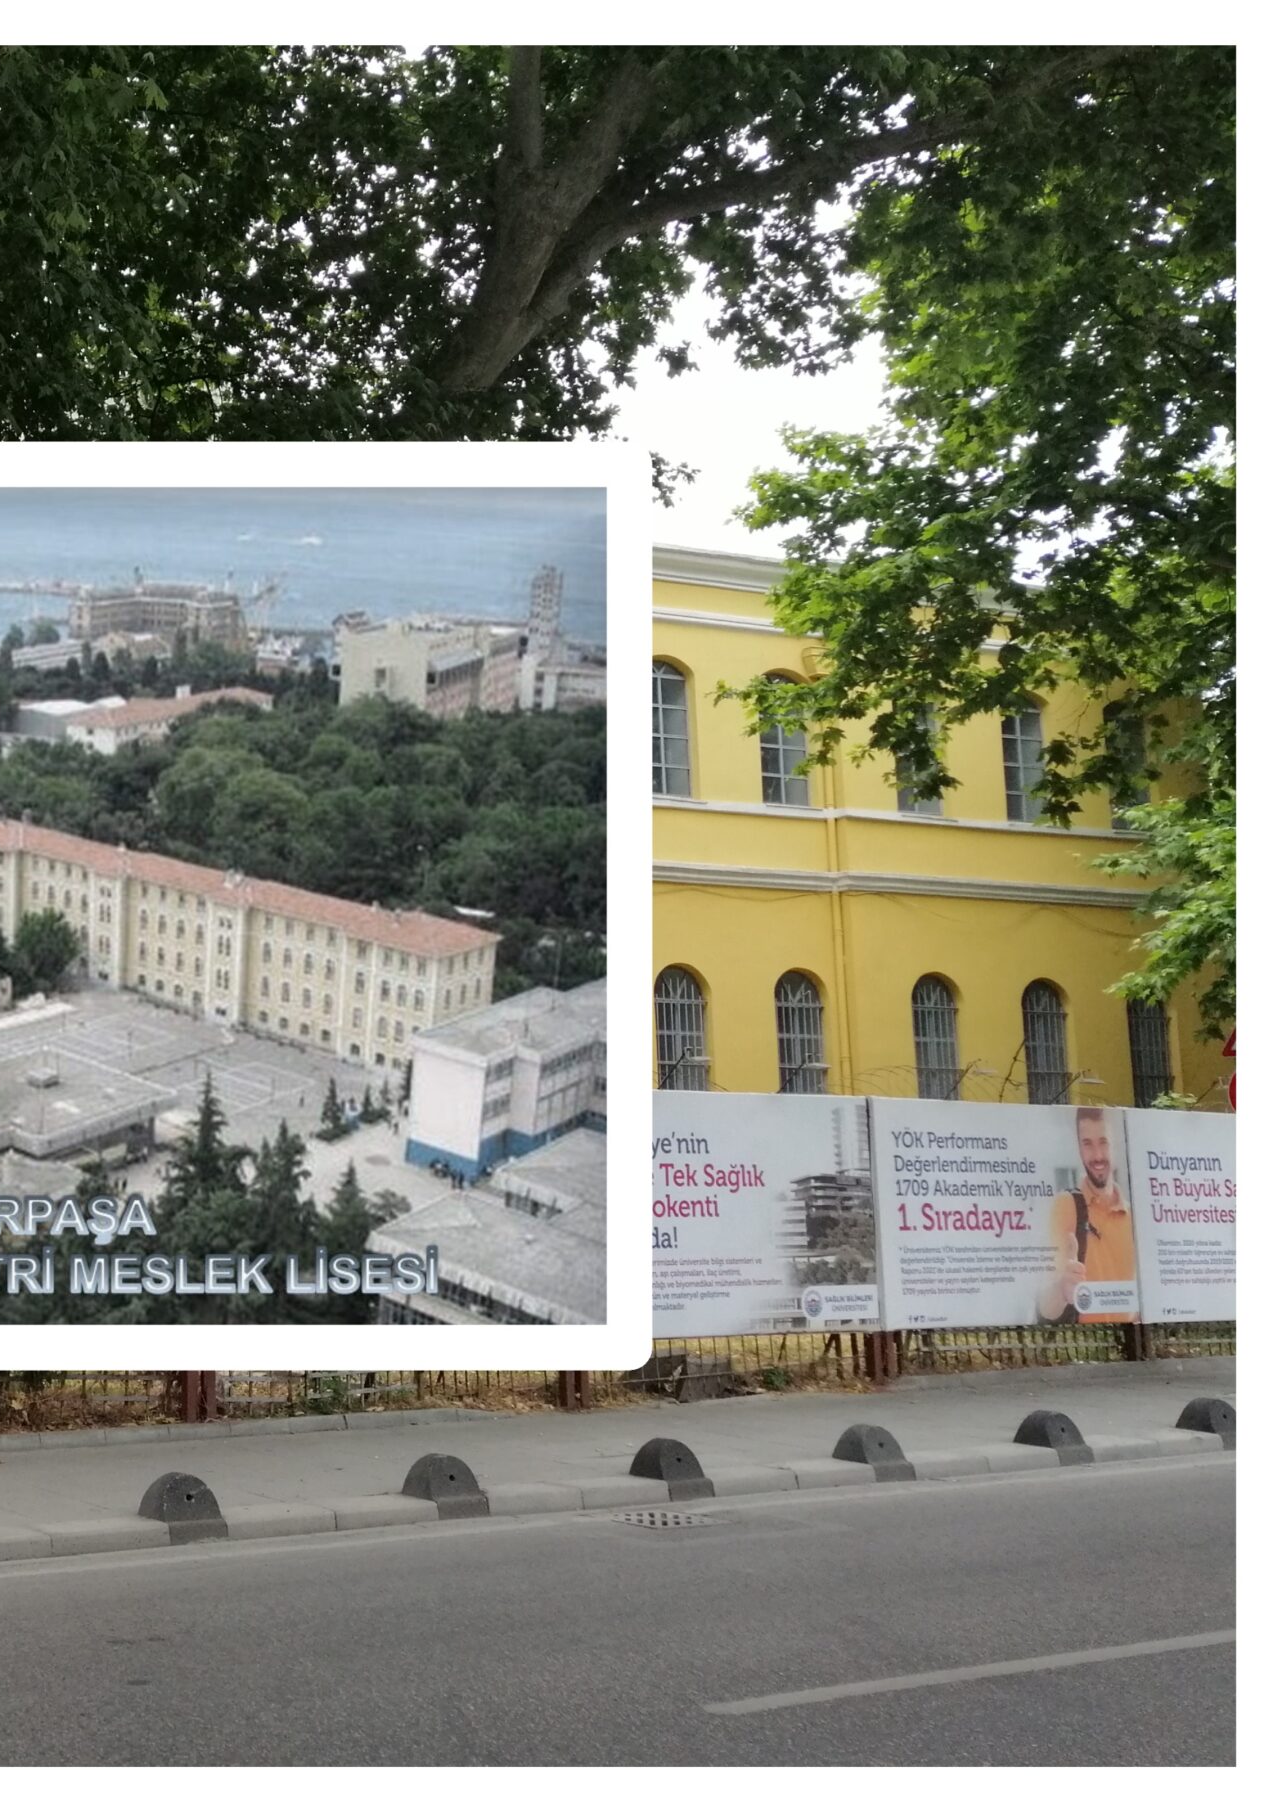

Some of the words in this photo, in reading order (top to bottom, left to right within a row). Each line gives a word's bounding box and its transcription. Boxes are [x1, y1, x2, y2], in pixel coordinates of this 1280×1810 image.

[891, 1127, 924, 1149] YÖK
[927, 1132, 1008, 1150] Performans
[893, 1155, 1036, 1176] Değerlendirmesinde
[1147, 1151, 1222, 1176] Dünyanın
[659, 1163, 698, 1187] Tek
[703, 1163, 766, 1193] Sağlık
[895, 1179, 929, 1197] 1709
[933, 1179, 1003, 1197] Akademik
[1005, 1180, 1054, 1201] Yayınla
[1149, 1177, 1170, 1197] En
[1173, 1178, 1222, 1202] Büyük
[652, 1194, 720, 1218] okenti
[897, 1203, 917, 1231] 1.
[1151, 1199, 1236, 1224] Üniversites
